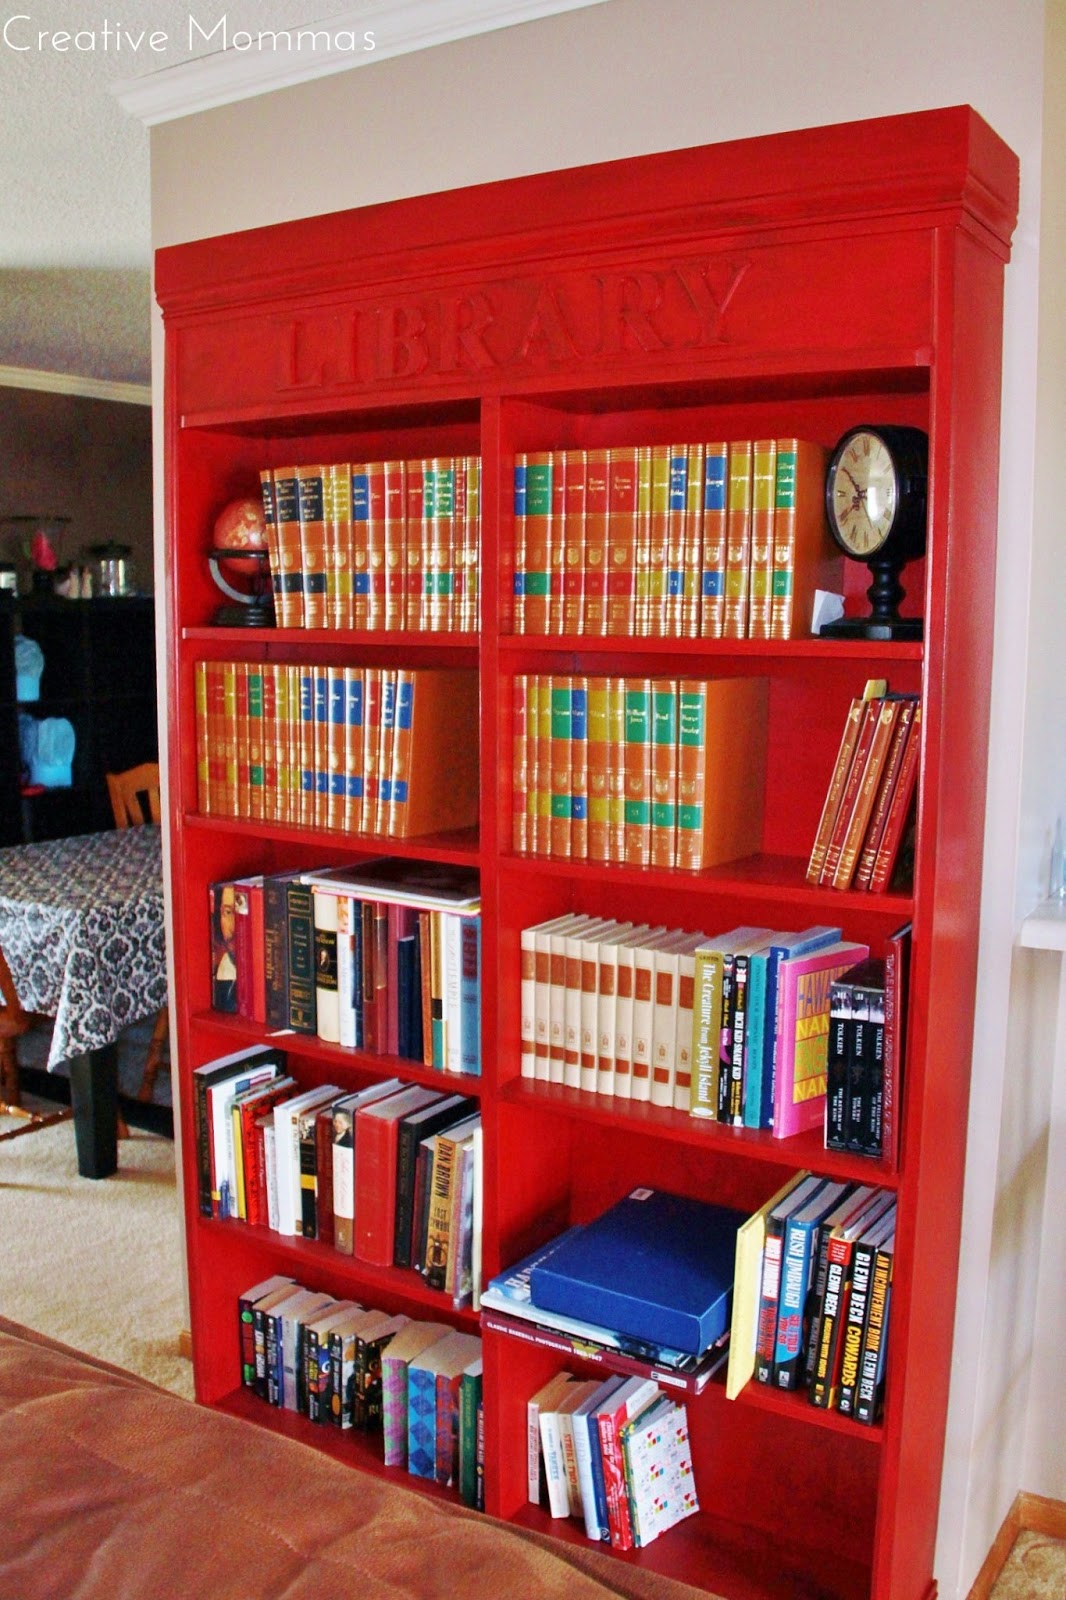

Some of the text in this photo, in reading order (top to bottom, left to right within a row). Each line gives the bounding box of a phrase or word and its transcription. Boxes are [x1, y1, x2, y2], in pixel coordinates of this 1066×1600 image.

[275, 258, 754, 392] LIBRARY
[696, 963, 716, 1102] The Creature from Jekyll Island
[732, 1011, 743, 1080] RICH KID SMART KID
[855, 1024, 863, 1057] TOLKIEN
[837, 1123, 842, 1131] OF
[434, 1143, 452, 1200] DAN BROWN
[784, 1228, 806, 1308] RUSH LIMBAUGH
[824, 1264, 842, 1317] GLENN BECK
[487, 1322, 508, 1335] CLASSIC
[508, 1329, 535, 1342] BASEBALL
[535, 1337, 572, 1353] PHOTOGRAPHS
[841, 1252, 871, 1387] GLENN BECK COWARDS
[859, 1254, 890, 1401] AN INCONVENIENT BOOK GLENN BECK
[817, 1359, 828, 1378] IDIOTS
[821, 1343, 830, 1358] WITH
[564, 1434, 577, 1484] STRIKE TWO
